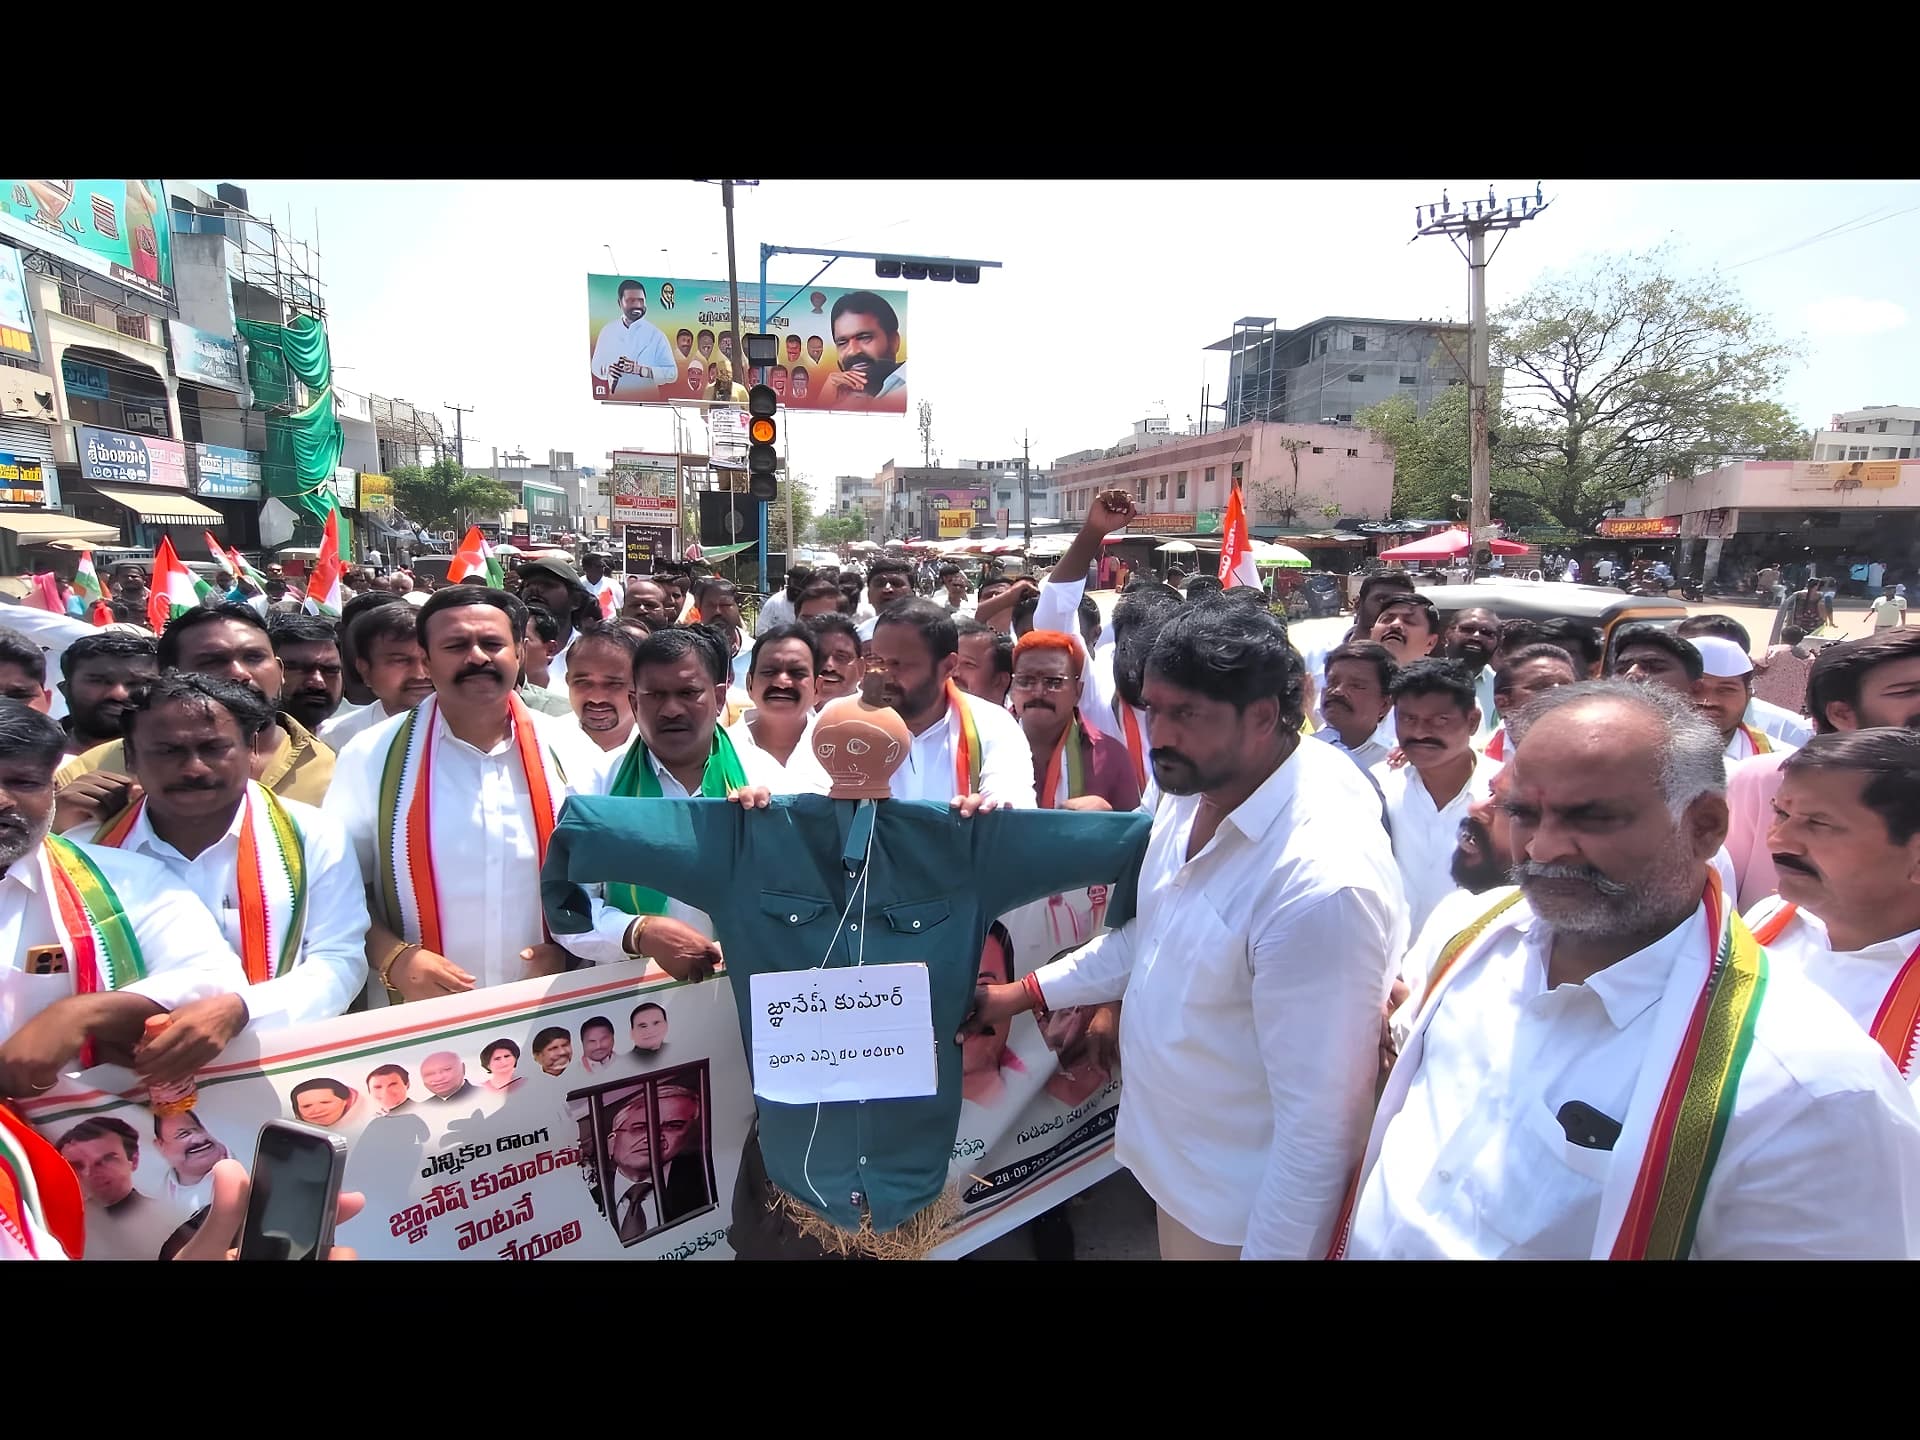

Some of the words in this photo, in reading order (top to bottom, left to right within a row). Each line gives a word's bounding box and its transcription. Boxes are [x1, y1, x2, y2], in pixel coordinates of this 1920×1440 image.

[834, 986, 903, 1010] కుమార్
[421, 1143, 492, 1179] ఎన్నికల
[496, 1127, 549, 1153] దొంగ
[389, 1180, 469, 1244] జ్ఞానేష్
[455, 1192, 535, 1251] వెంటనే
